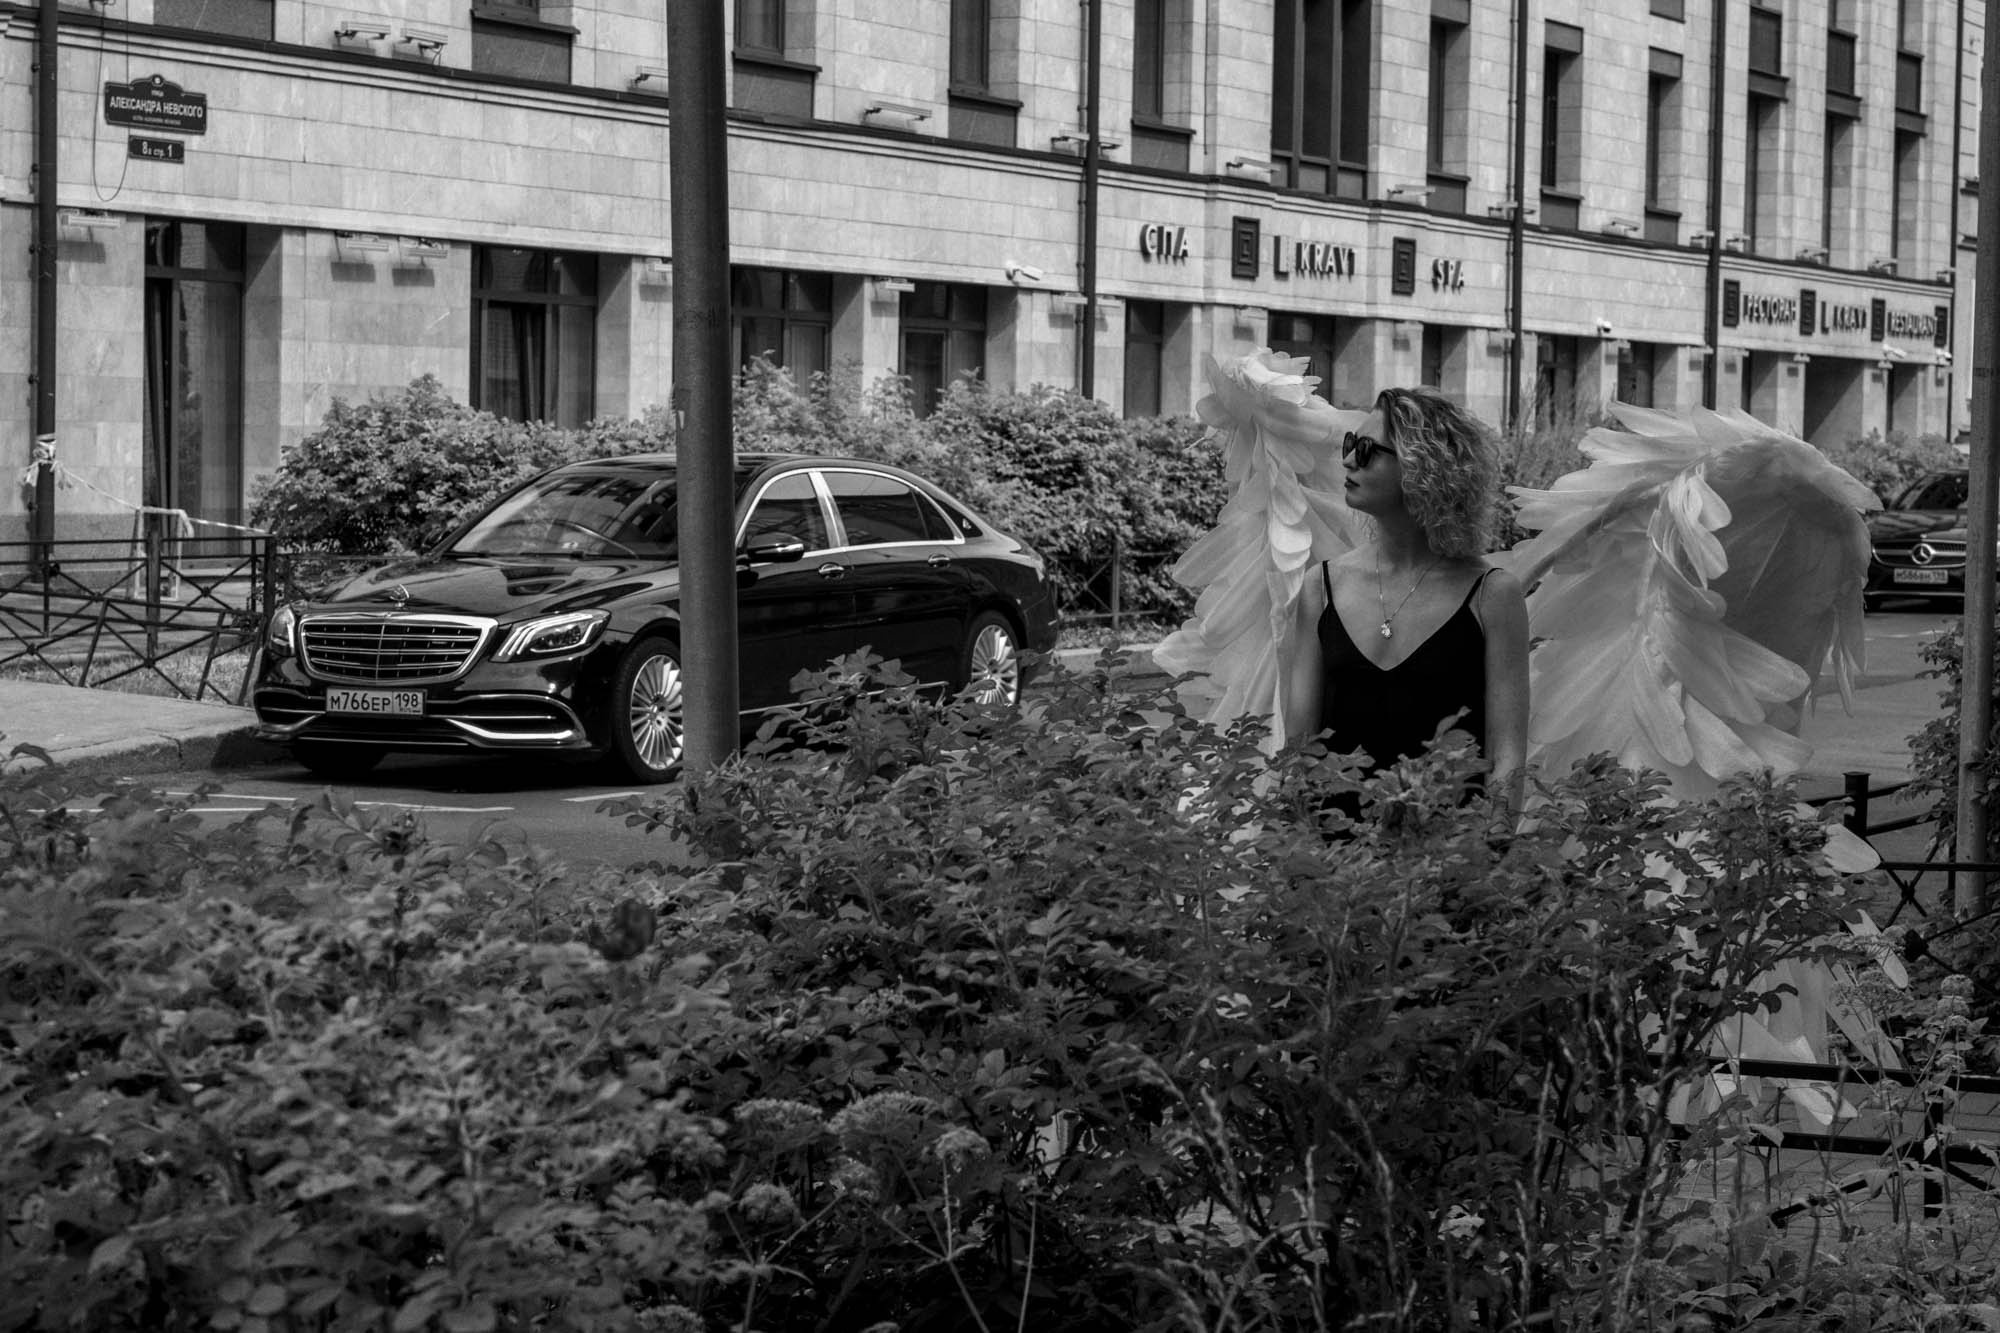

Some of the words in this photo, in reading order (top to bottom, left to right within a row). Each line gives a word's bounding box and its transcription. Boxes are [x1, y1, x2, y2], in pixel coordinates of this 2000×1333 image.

[109, 96, 162, 114] АЛЕКСАНДРА
[163, 102, 203, 118] НЕВСКОГО
[168, 143, 173, 158] 1
[1140, 223, 1189, 262] СПА
[1431, 258, 1465, 293] SPA
[1743, 294, 1797, 325] РЕСТОРАН
[330, 691, 392, 711] М766ЕР
[394, 692, 419, 708] 198
